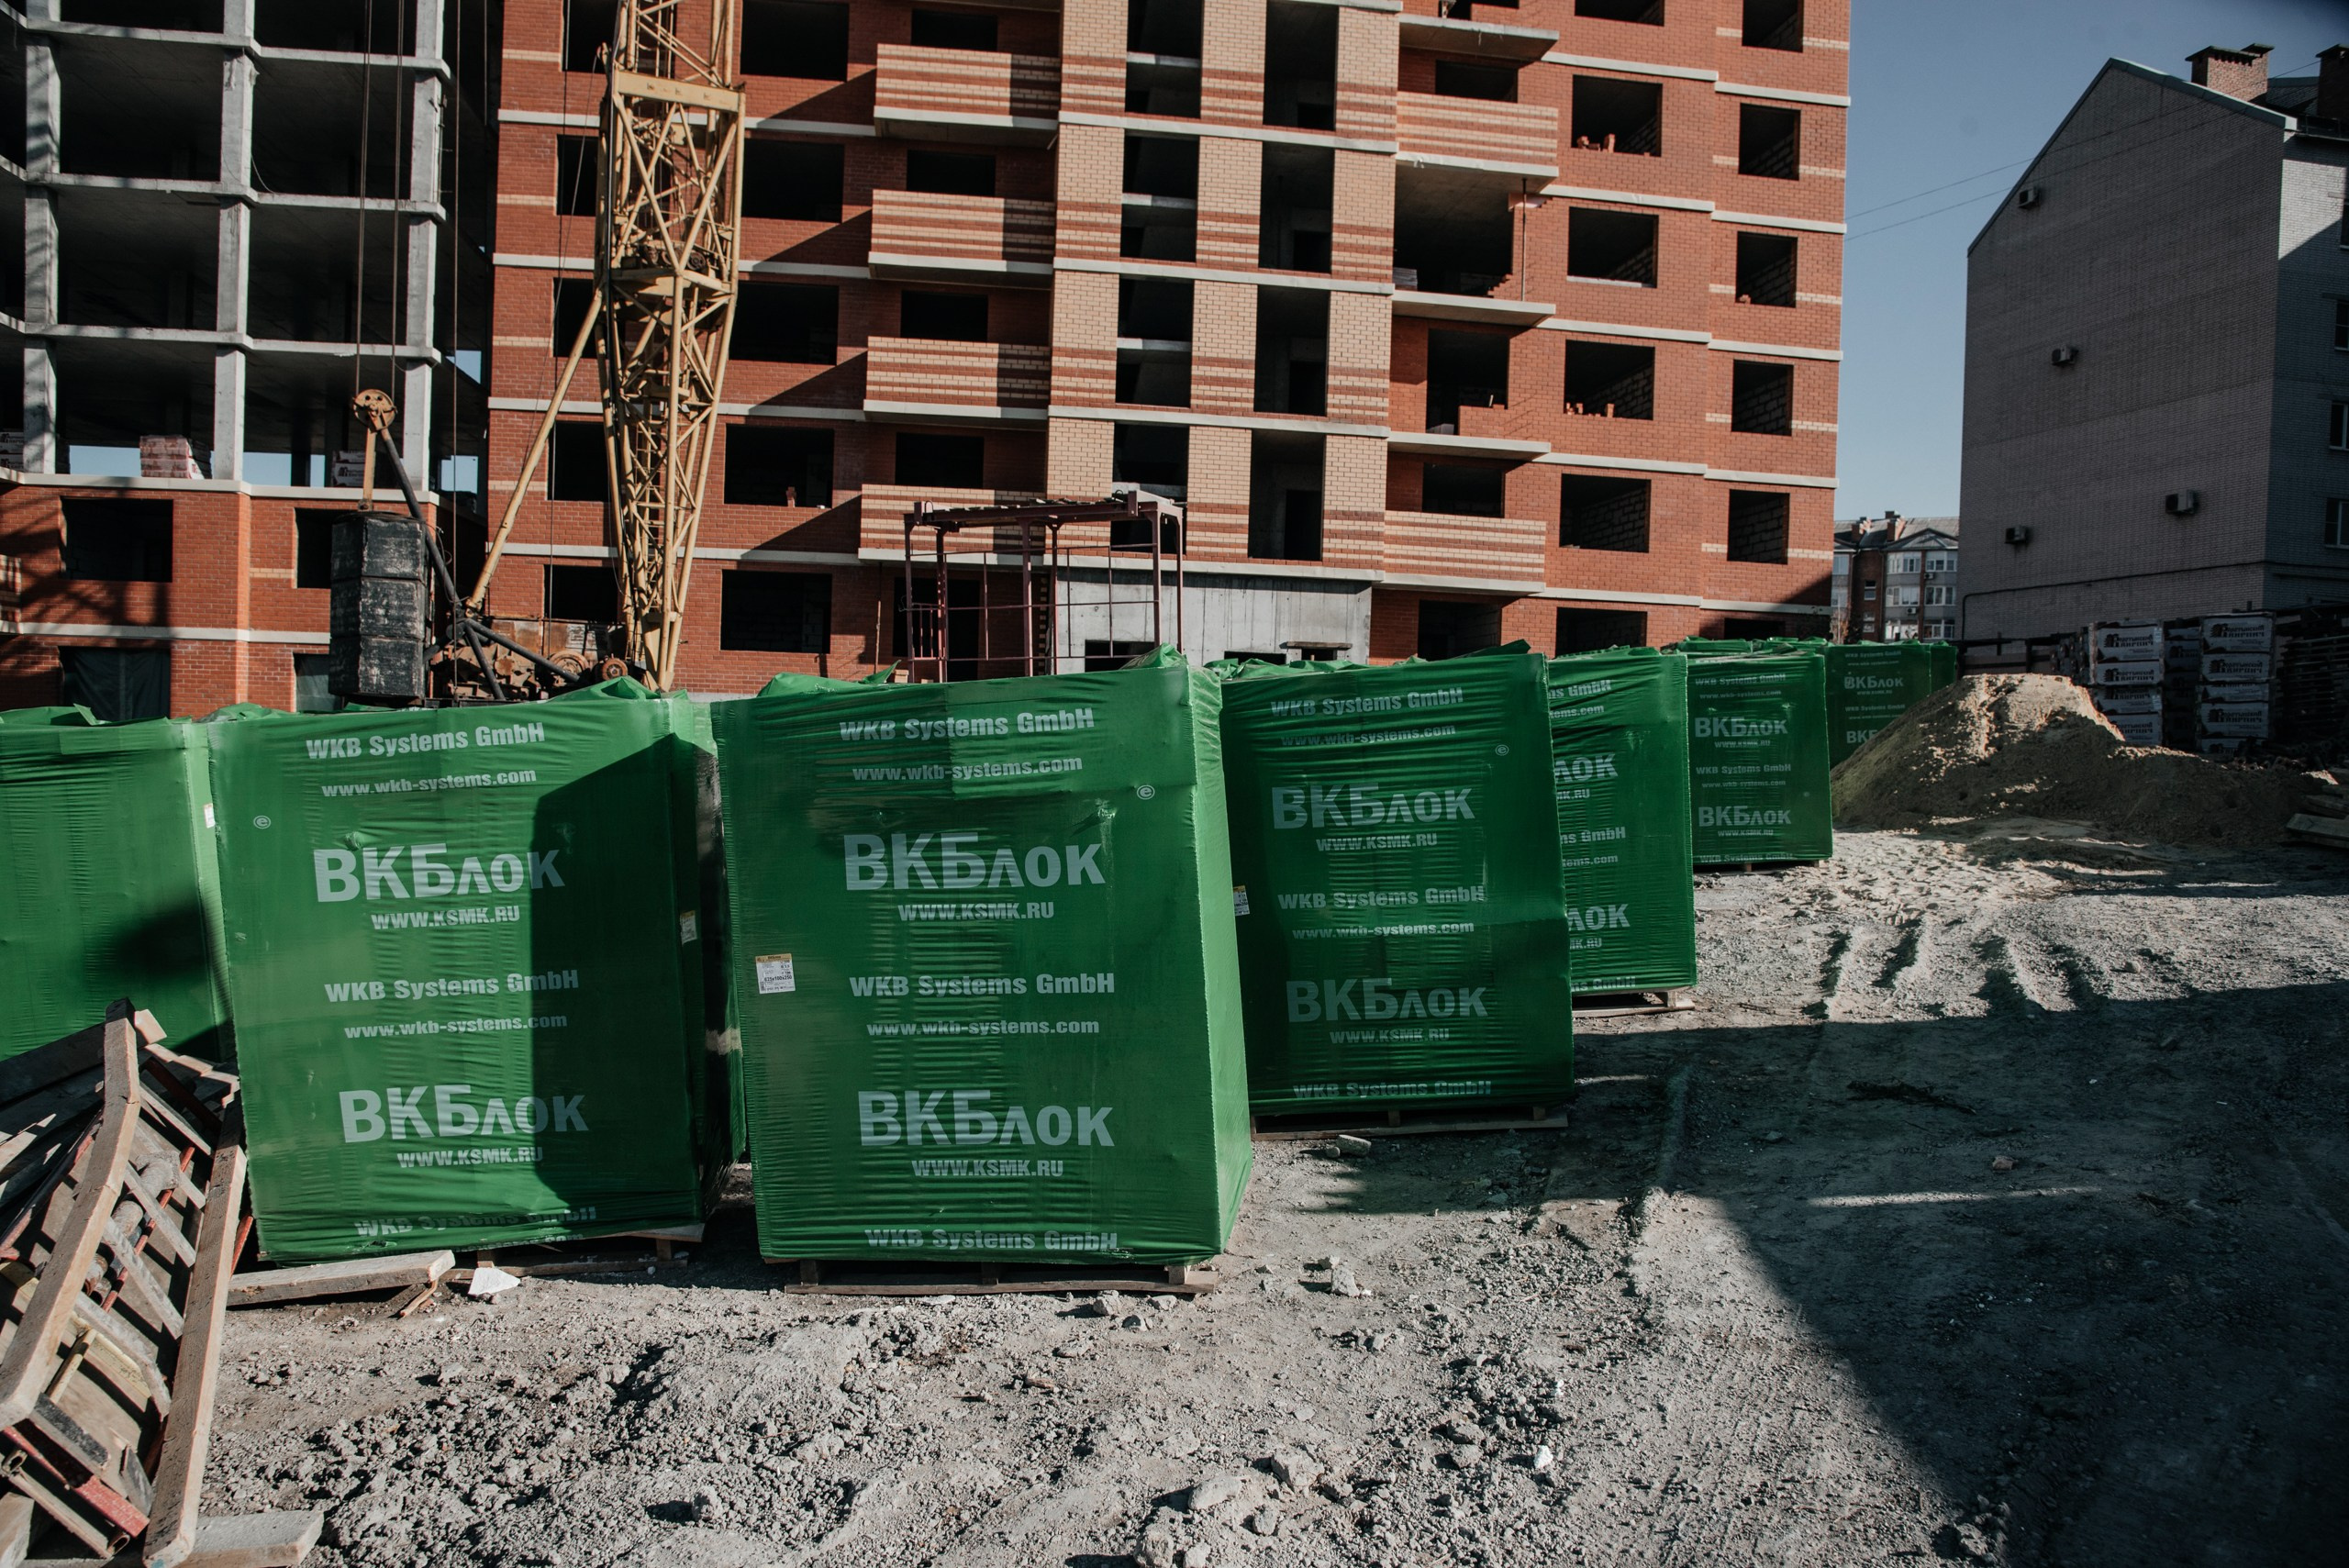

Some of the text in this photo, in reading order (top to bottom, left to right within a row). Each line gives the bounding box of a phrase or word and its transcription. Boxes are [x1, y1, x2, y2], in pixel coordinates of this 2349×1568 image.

[1271, 687, 1464, 717] WKB Systems GmbH
[840, 707, 1094, 740] WKB Systems GmbH
[306, 722, 545, 759] WKB Systems GmbH
[1281, 725, 1456, 746] www.wkb-systems.com
[852, 757, 1082, 780] www.wkb-systems.com
[1696, 764, 1791, 774] WKB Systems GmbH
[1316, 833, 1437, 851] WWW.KSMK.RU
[1581, 827, 1626, 842] GmbH
[1277, 886, 1485, 909] WKB Systems GmbH
[371, 906, 520, 930] WWW.KSMK.RU
[897, 902, 1054, 921] WWW.KSMK.RU
[324, 970, 579, 1002] WKB Systems GmbH
[849, 973, 1115, 997] WKB Systems GmbH
[344, 1016, 567, 1038] www.wkb-systems.com
[866, 1019, 1099, 1036] www.wkb-systems.com
[1330, 1028, 1450, 1044] WWW.KSMK.RU
[1292, 1081, 1491, 1099] WKB Systems GmbH
[397, 1147, 542, 1168] WWW.KSMK.RU
[911, 1160, 1063, 1177] WWW.KSMK.RU
[864, 1229, 1118, 1251] WKB Systems GmbH
